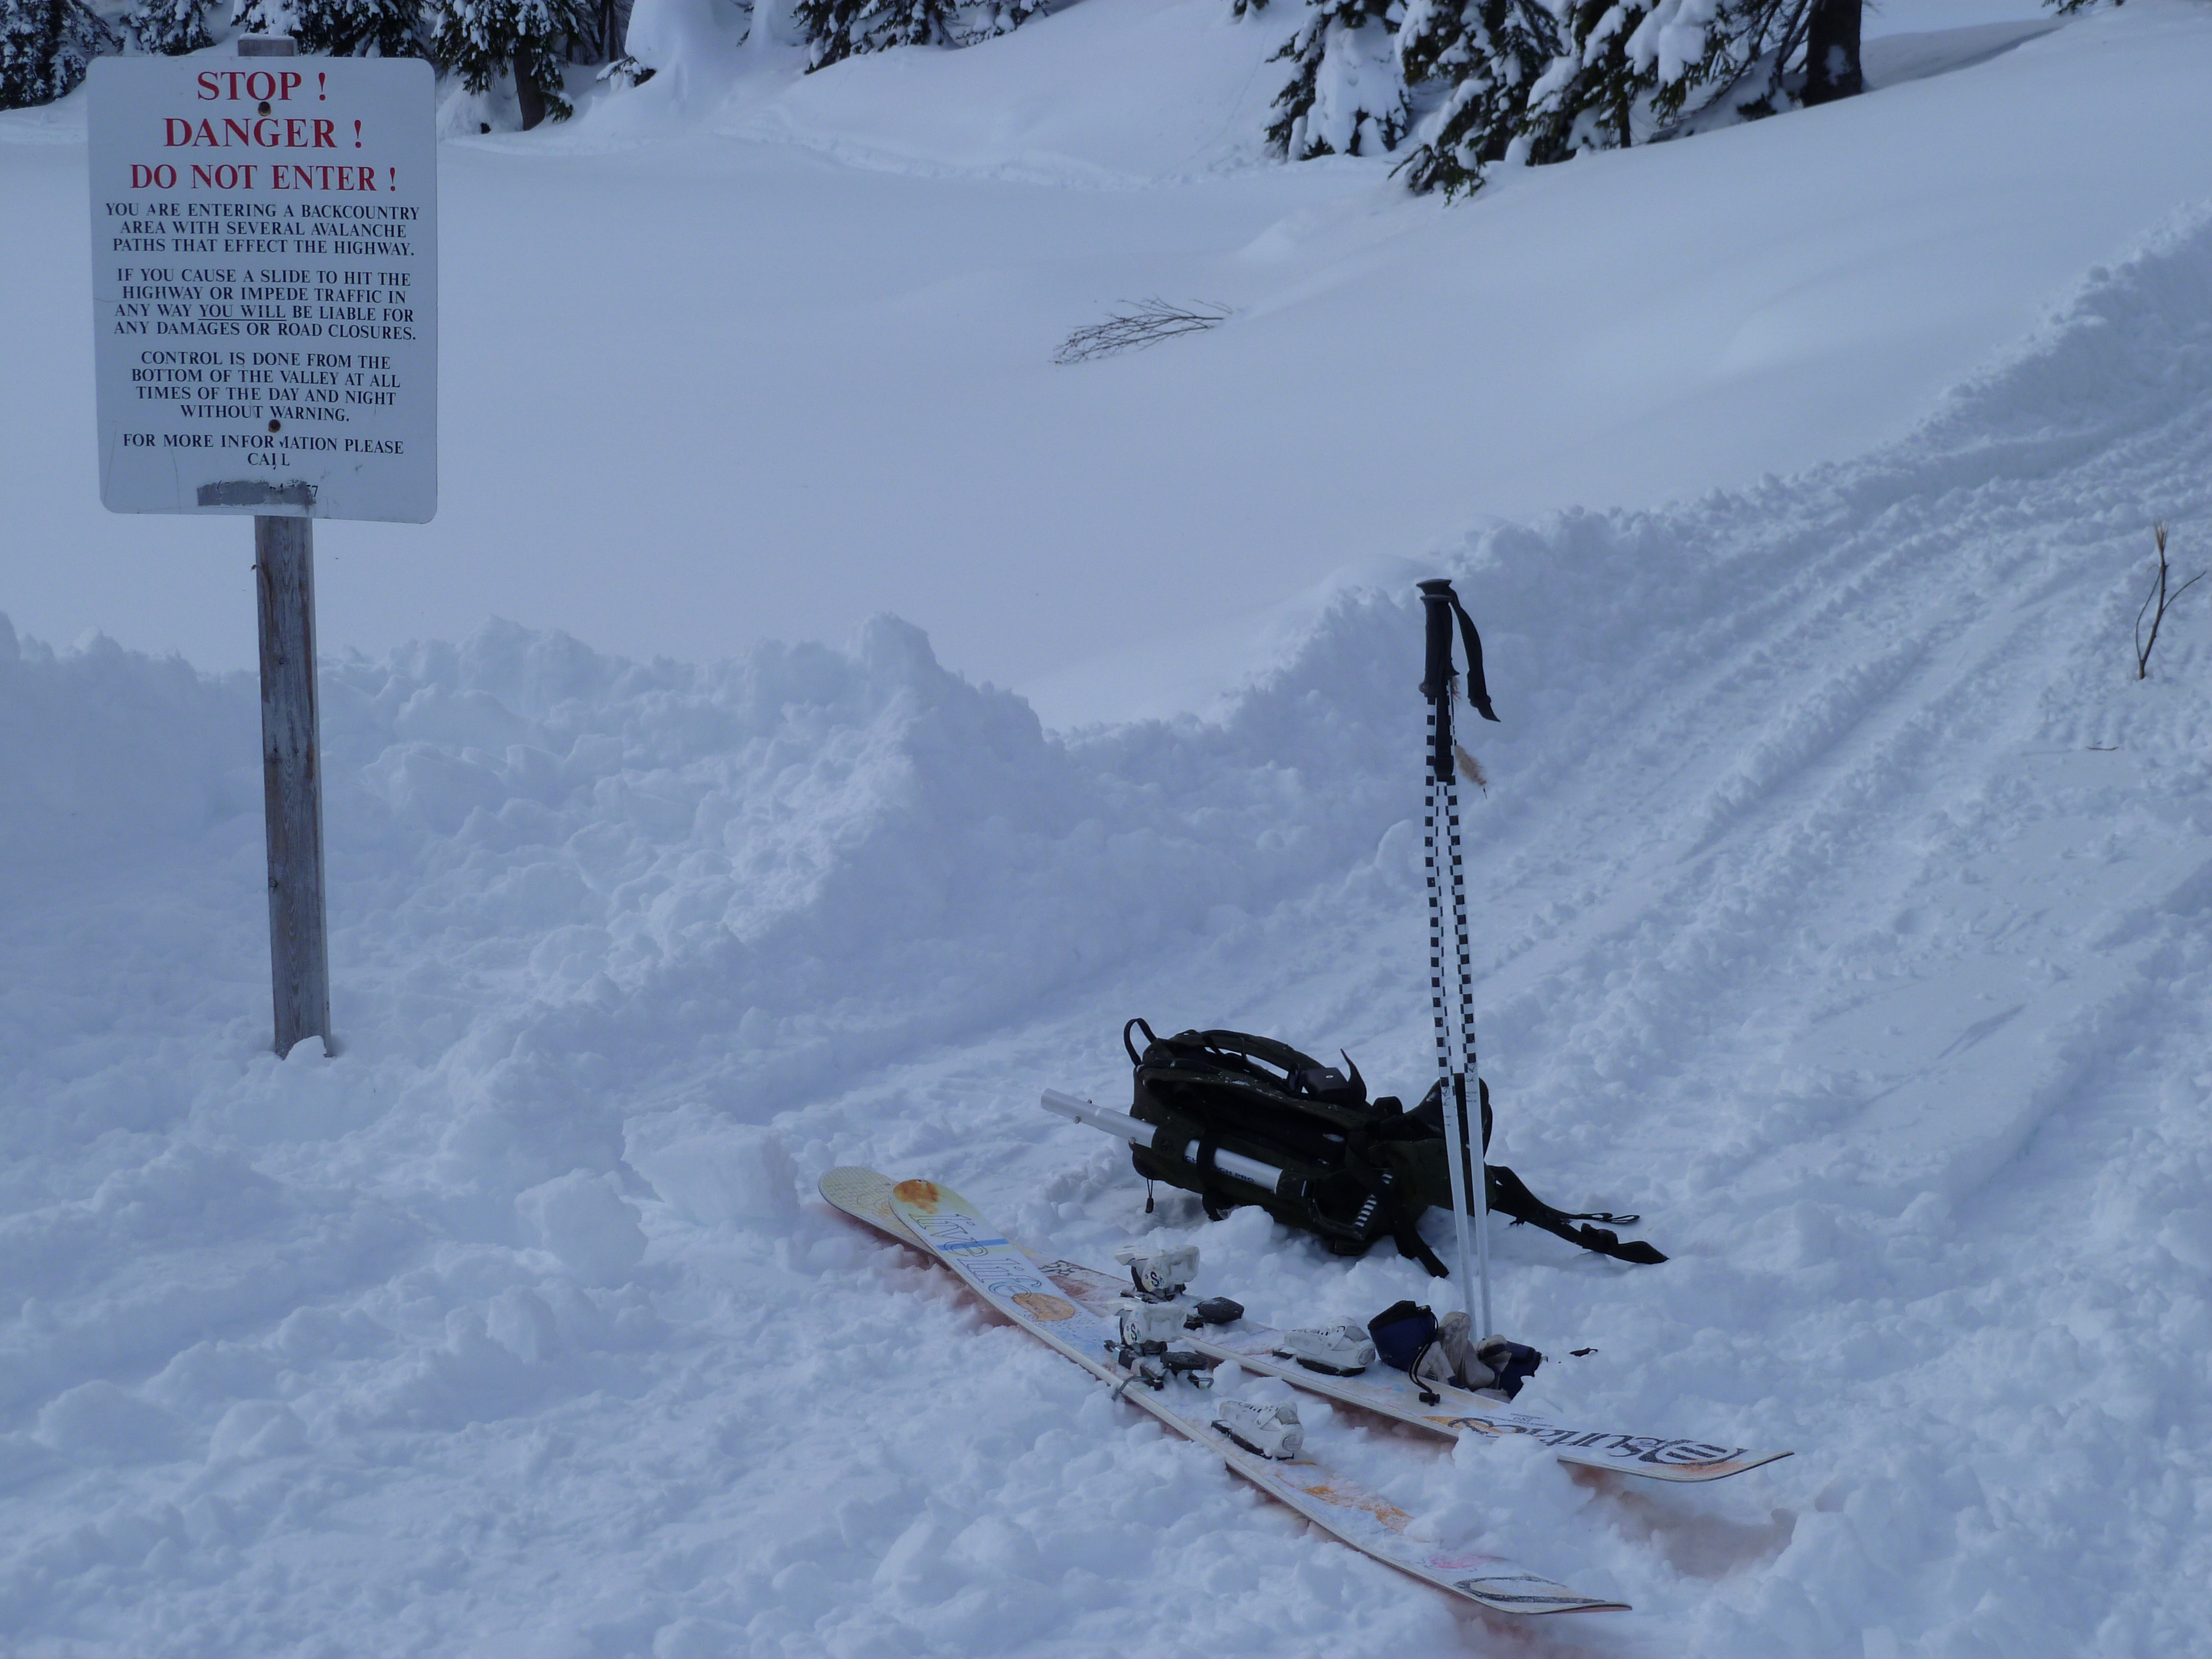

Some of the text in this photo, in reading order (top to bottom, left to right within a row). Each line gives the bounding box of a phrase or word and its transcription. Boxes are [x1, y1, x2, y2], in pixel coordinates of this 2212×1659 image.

[198, 71, 302, 101] STOP
[163, 118, 337, 148] DANGER
[130, 164, 177, 189] DO
[190, 164, 258, 189] NOT
[270, 165, 377, 191] ENTER
[105, 202, 420, 220] YOU ARE ENTERING A BACKCOUNTRY
[120, 221, 407, 238] AREA WITH SEVERAL AVALANCHE
[113, 238, 414, 256] PATHS THAT EFFECT THE HIGHWAY.
[117, 268, 411, 287] IF YOU CAUSE A SLIDE TO HIT THE
[122, 286, 406, 304] HIGHWAY OR IMPEDE TRAFFIC IN
[115, 304, 414, 323] ANY WAY YOU WILL BE LIABLE FOR
[114, 321, 416, 341] ANY DAMAGES OR ROAD CLOSURES.
[141, 351, 391, 370] CONTROL IS DONE FROM THE
[132, 368, 400, 388] BOTTOM OF THE VALLEY AT ALL
[136, 386, 396, 406] TIMES OF THE DAY AND NIGHT
[180, 405, 349, 422] WITHOUT WARNING.
[123, 433, 156, 447] FOR
[163, 434, 214, 448] MORE
[344, 438, 404, 454] PLEASE
[1235, 1172, 1254, 1182] PRO
